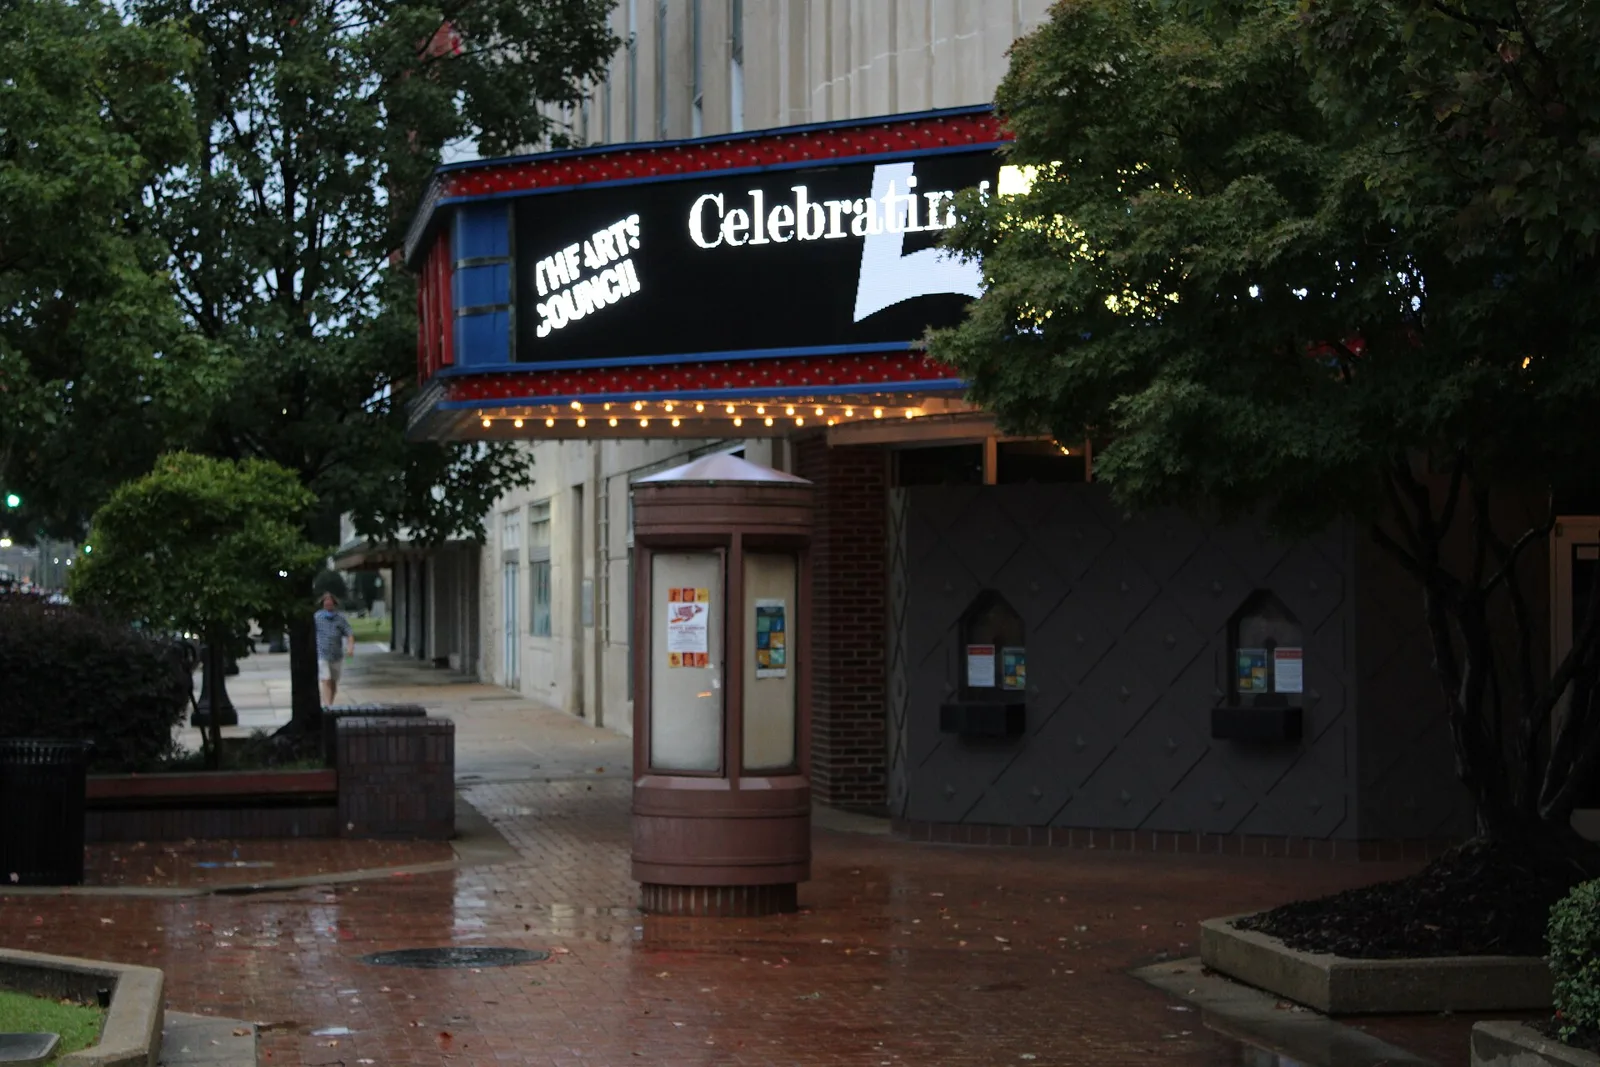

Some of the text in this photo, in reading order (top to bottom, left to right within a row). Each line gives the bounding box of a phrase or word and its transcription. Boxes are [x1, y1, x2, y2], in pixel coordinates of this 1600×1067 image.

[688, 175, 990, 249] Celebratin
[536, 213, 640, 297] THE ARTS
